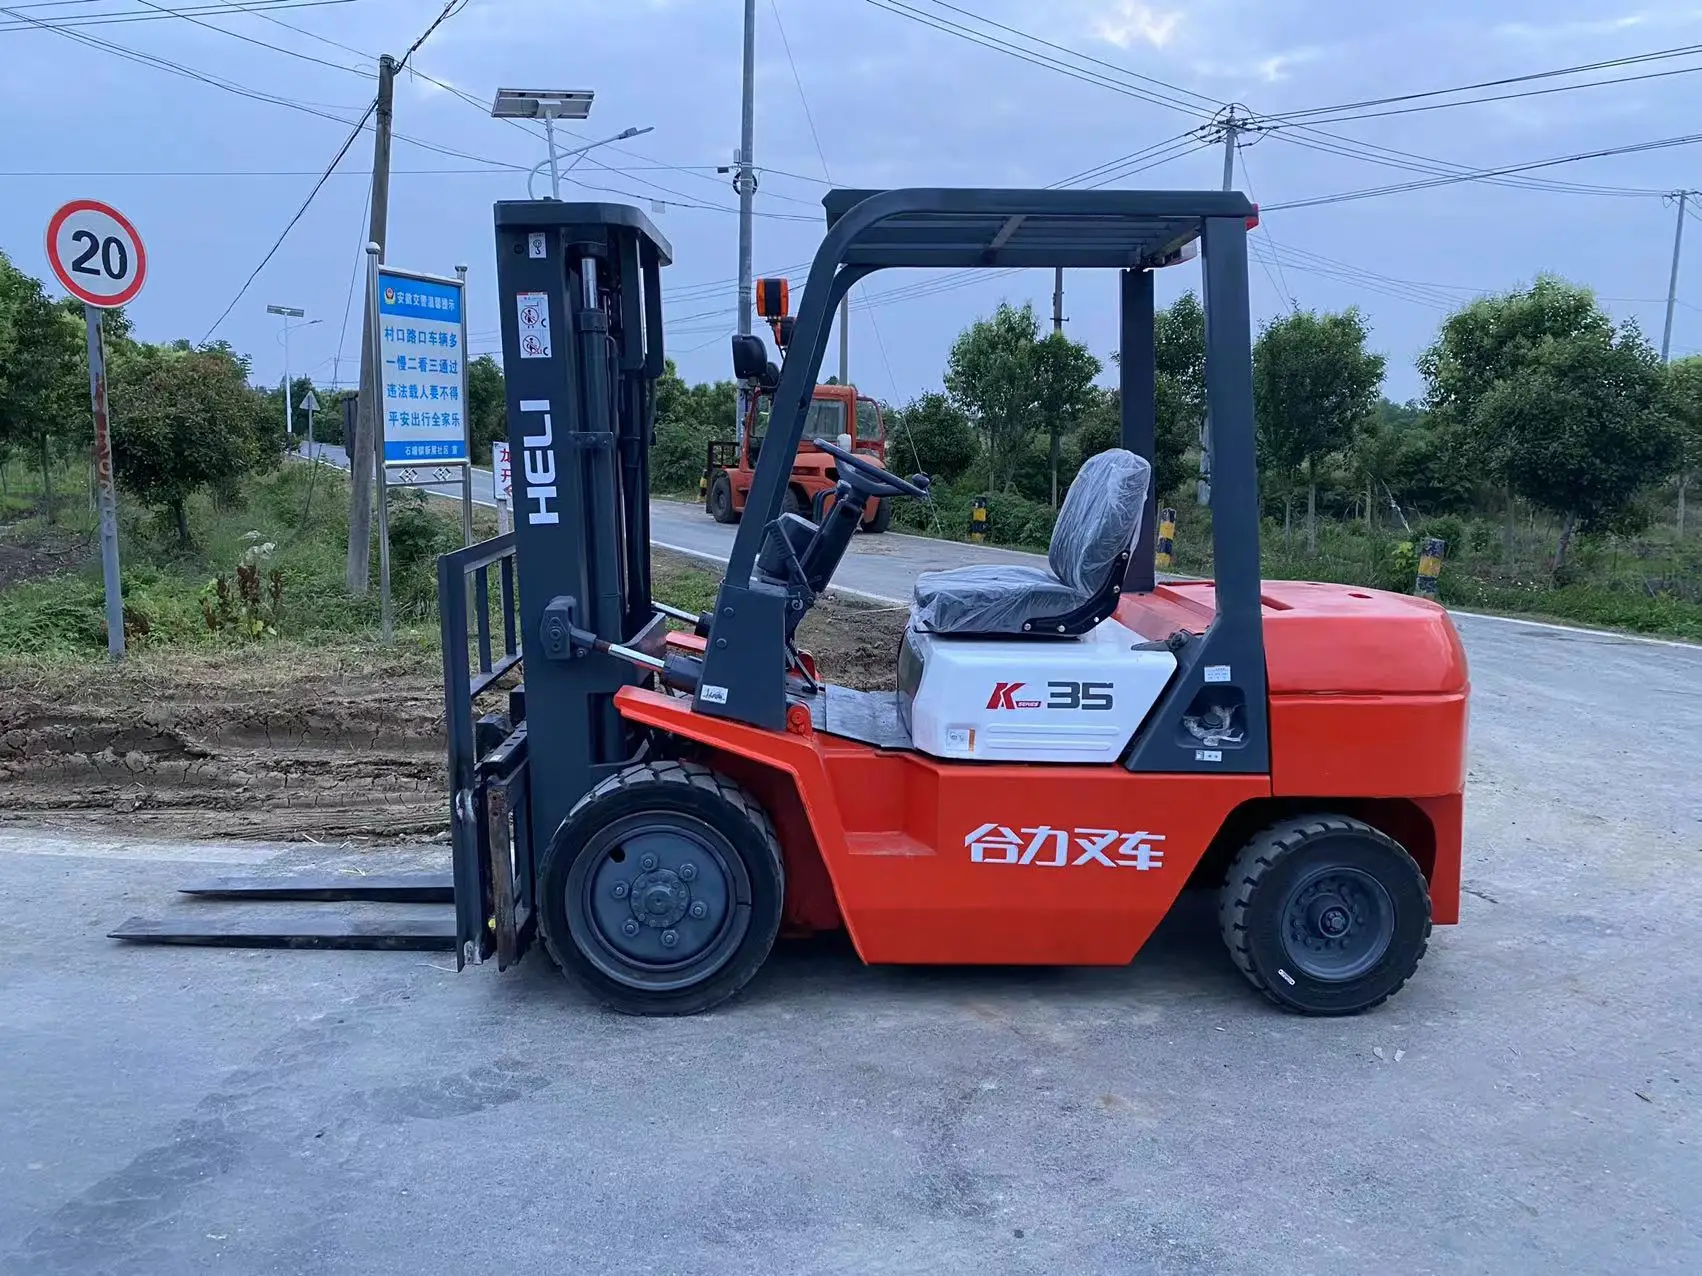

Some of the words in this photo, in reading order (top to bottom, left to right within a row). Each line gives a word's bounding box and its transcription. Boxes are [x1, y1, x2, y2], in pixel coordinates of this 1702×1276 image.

[72, 229, 128, 280] 20
[384, 326, 457, 347] 村口路口车辆多
[386, 355, 458, 374] 一慢二看三通过
[387, 383, 458, 400] 违法载人要不得
[388, 411, 460, 427] 平安出行全家乐
[520, 399, 559, 525] HELI
[986, 682, 1026, 710] K
[1047, 681, 1114, 711] 35
[965, 823, 1166, 871] 合力叉车
